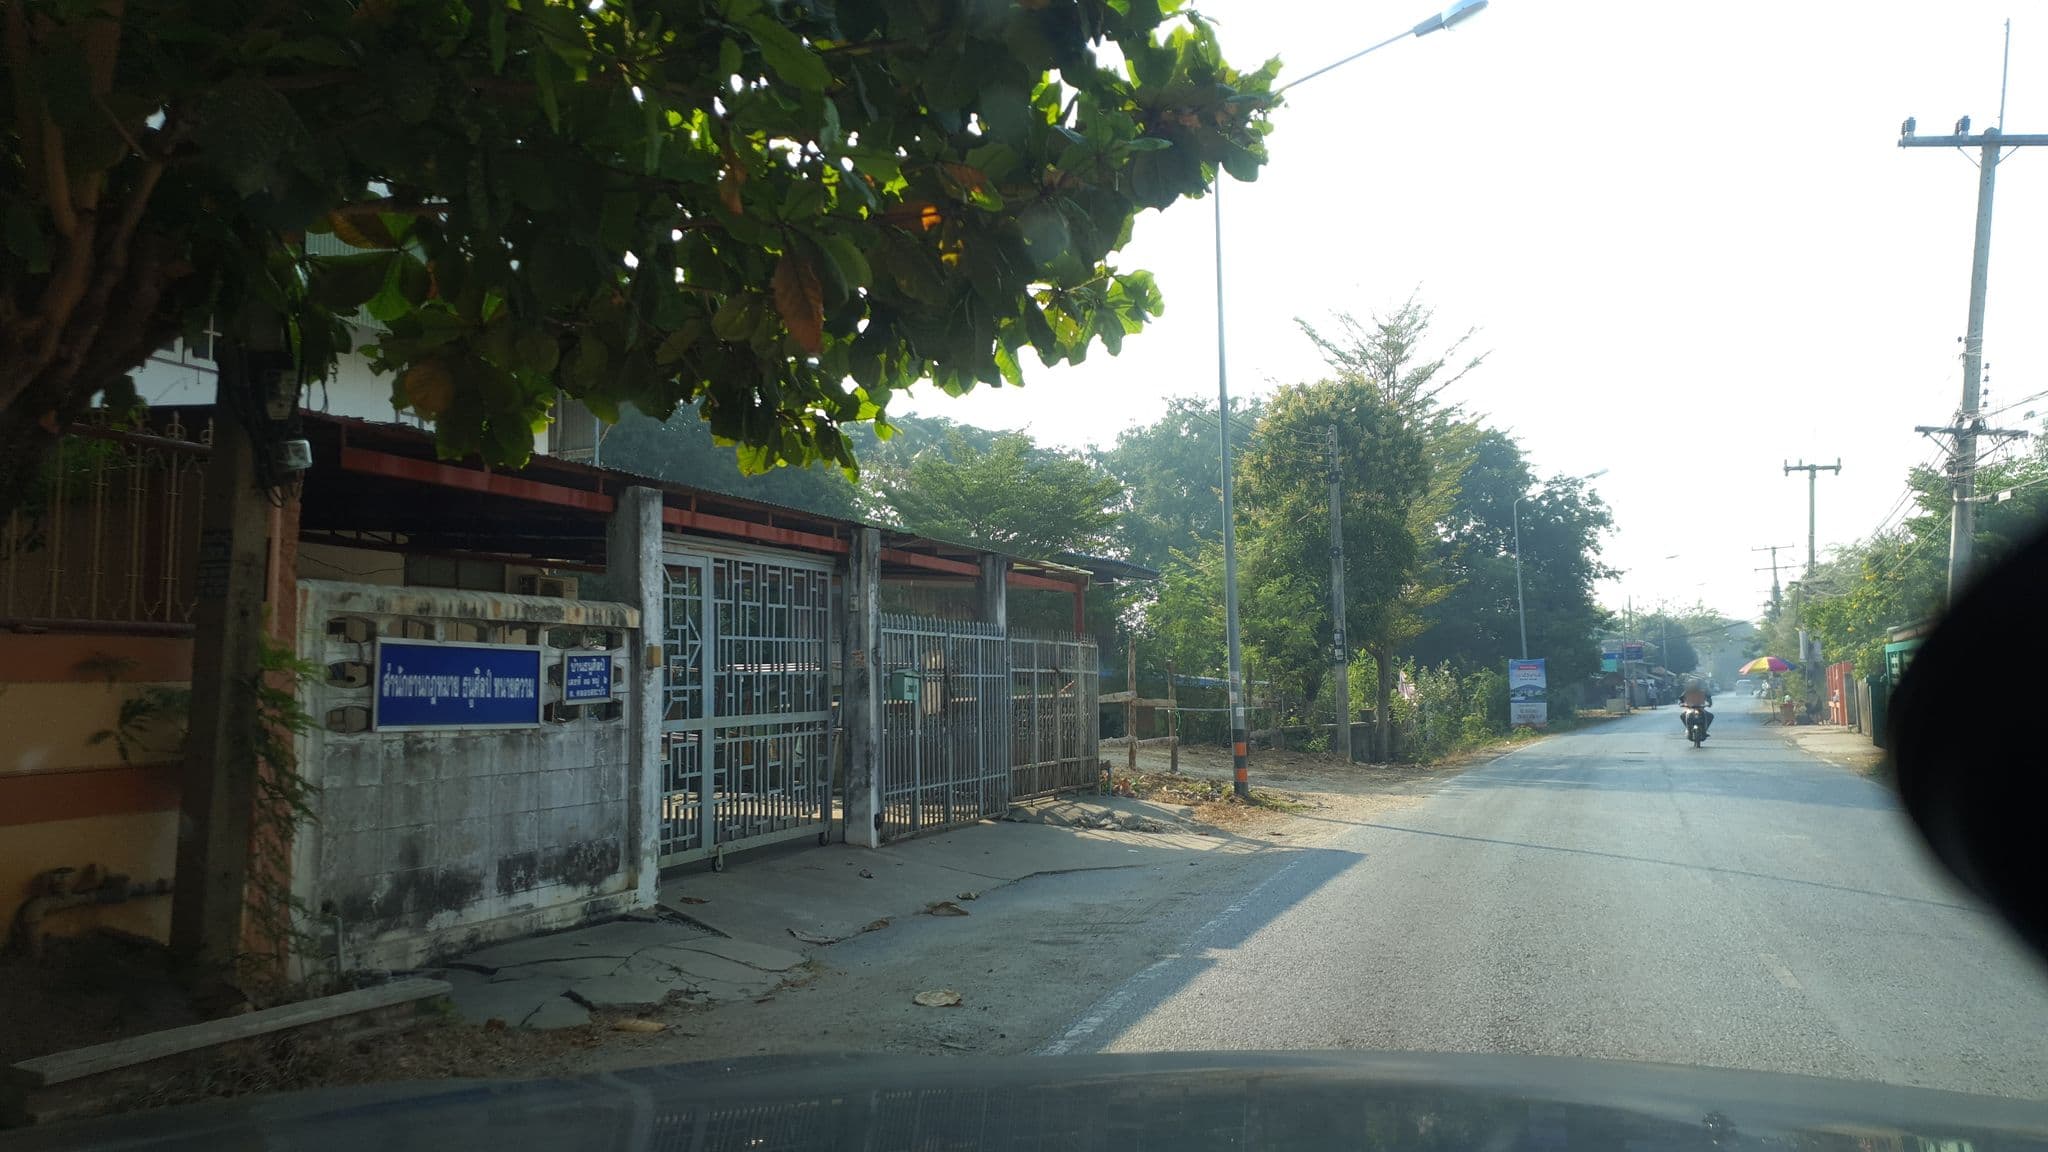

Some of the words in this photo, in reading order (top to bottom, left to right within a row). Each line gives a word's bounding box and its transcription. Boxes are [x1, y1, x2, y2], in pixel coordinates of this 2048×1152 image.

[383, 662, 460, 704] สำนักงานกฎหมาย
[493, 677, 535, 698] ทนายความ
